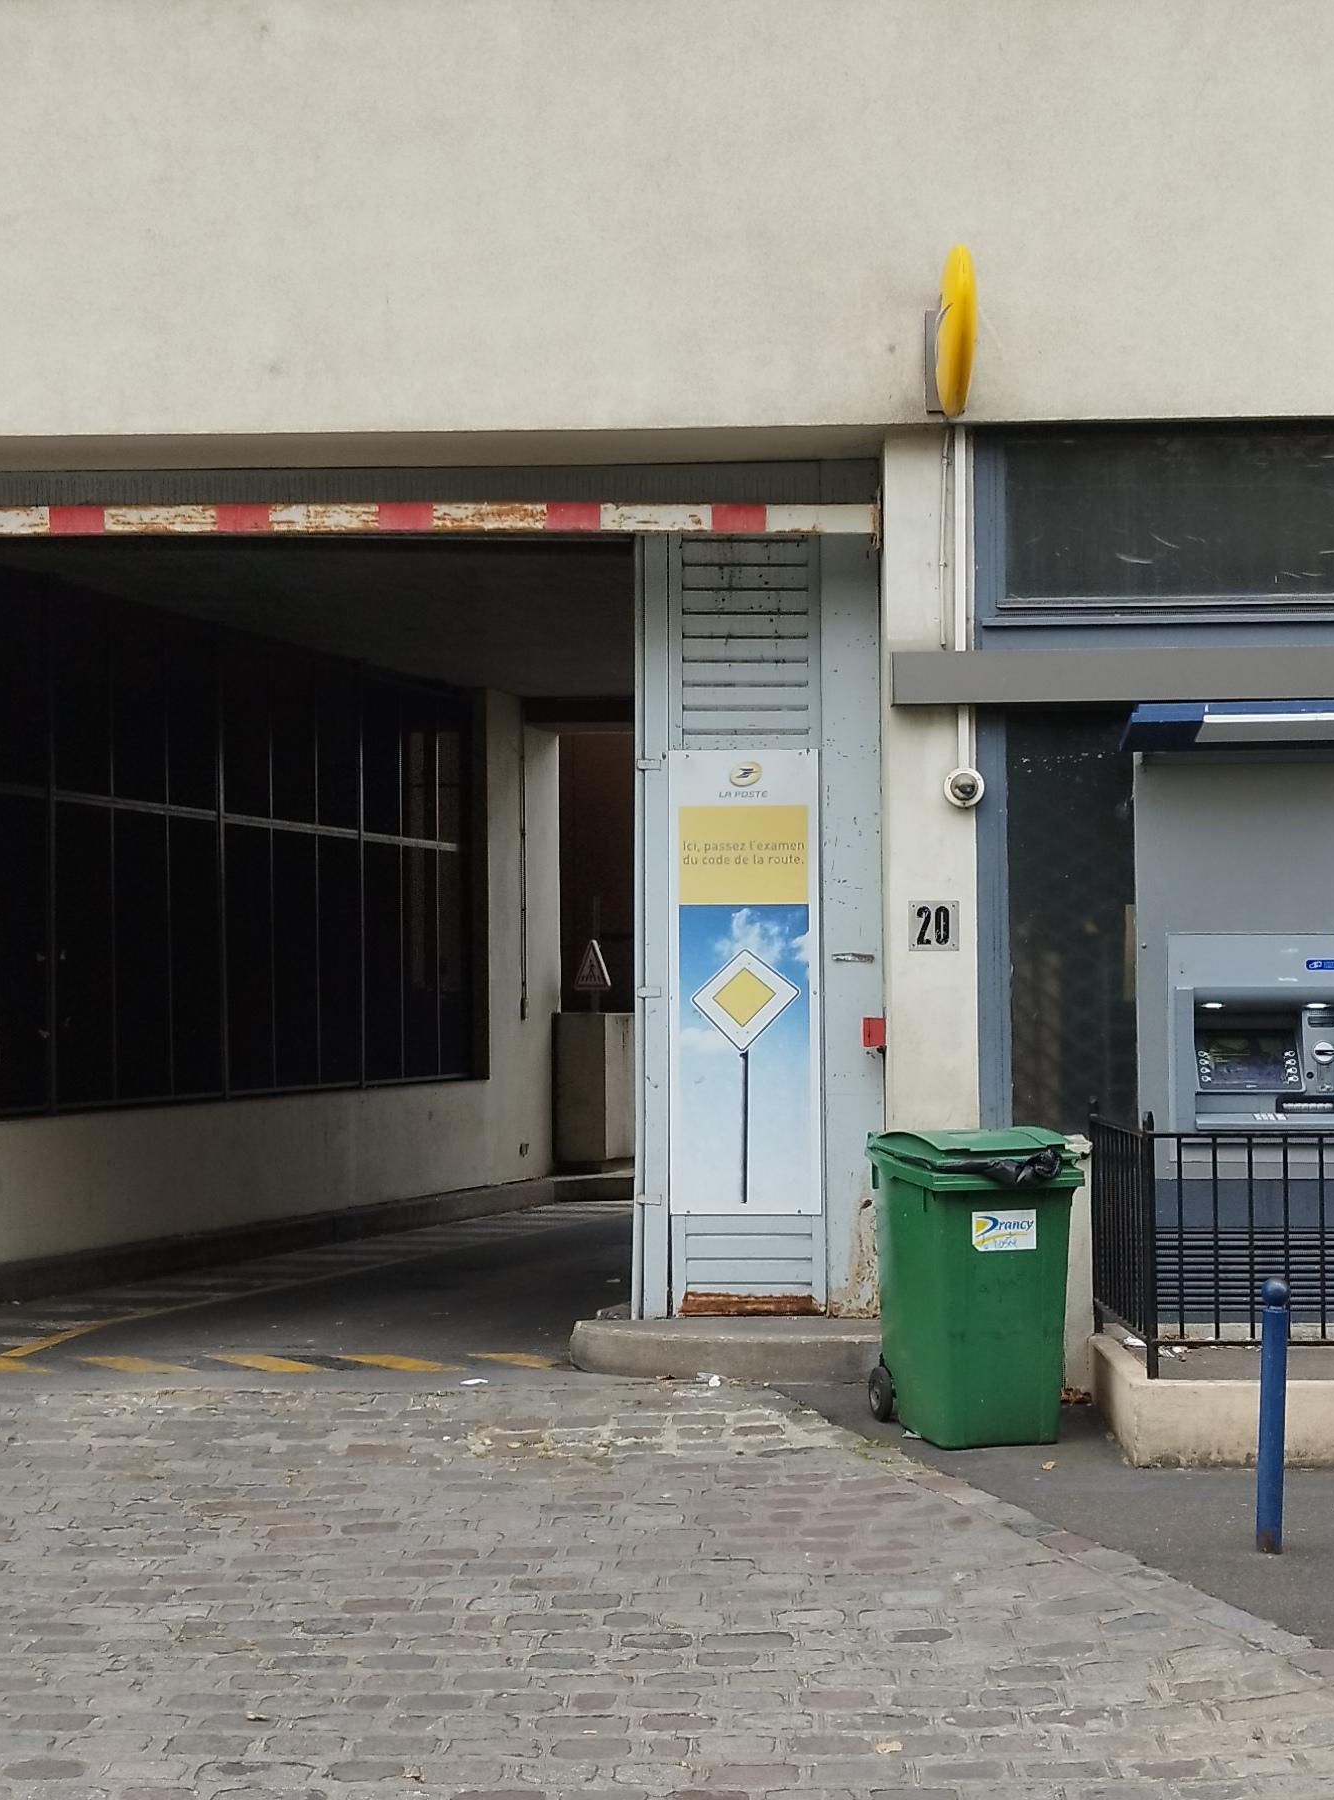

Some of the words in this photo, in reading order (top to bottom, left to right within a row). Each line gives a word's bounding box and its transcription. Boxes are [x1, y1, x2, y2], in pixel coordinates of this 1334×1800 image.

[719, 790, 732, 799] LA
[734, 790, 769, 799] POSTE
[683, 841, 700, 853] Ici,
[704, 843, 746, 854] passez
[749, 840, 805, 852] l'examen
[683, 854, 698, 865] du
[702, 854, 730, 865] code
[734, 854, 749, 865] de
[753, 854, 764, 865] la
[768, 855, 805, 865] route.
[916, 905, 950, 946] 20
